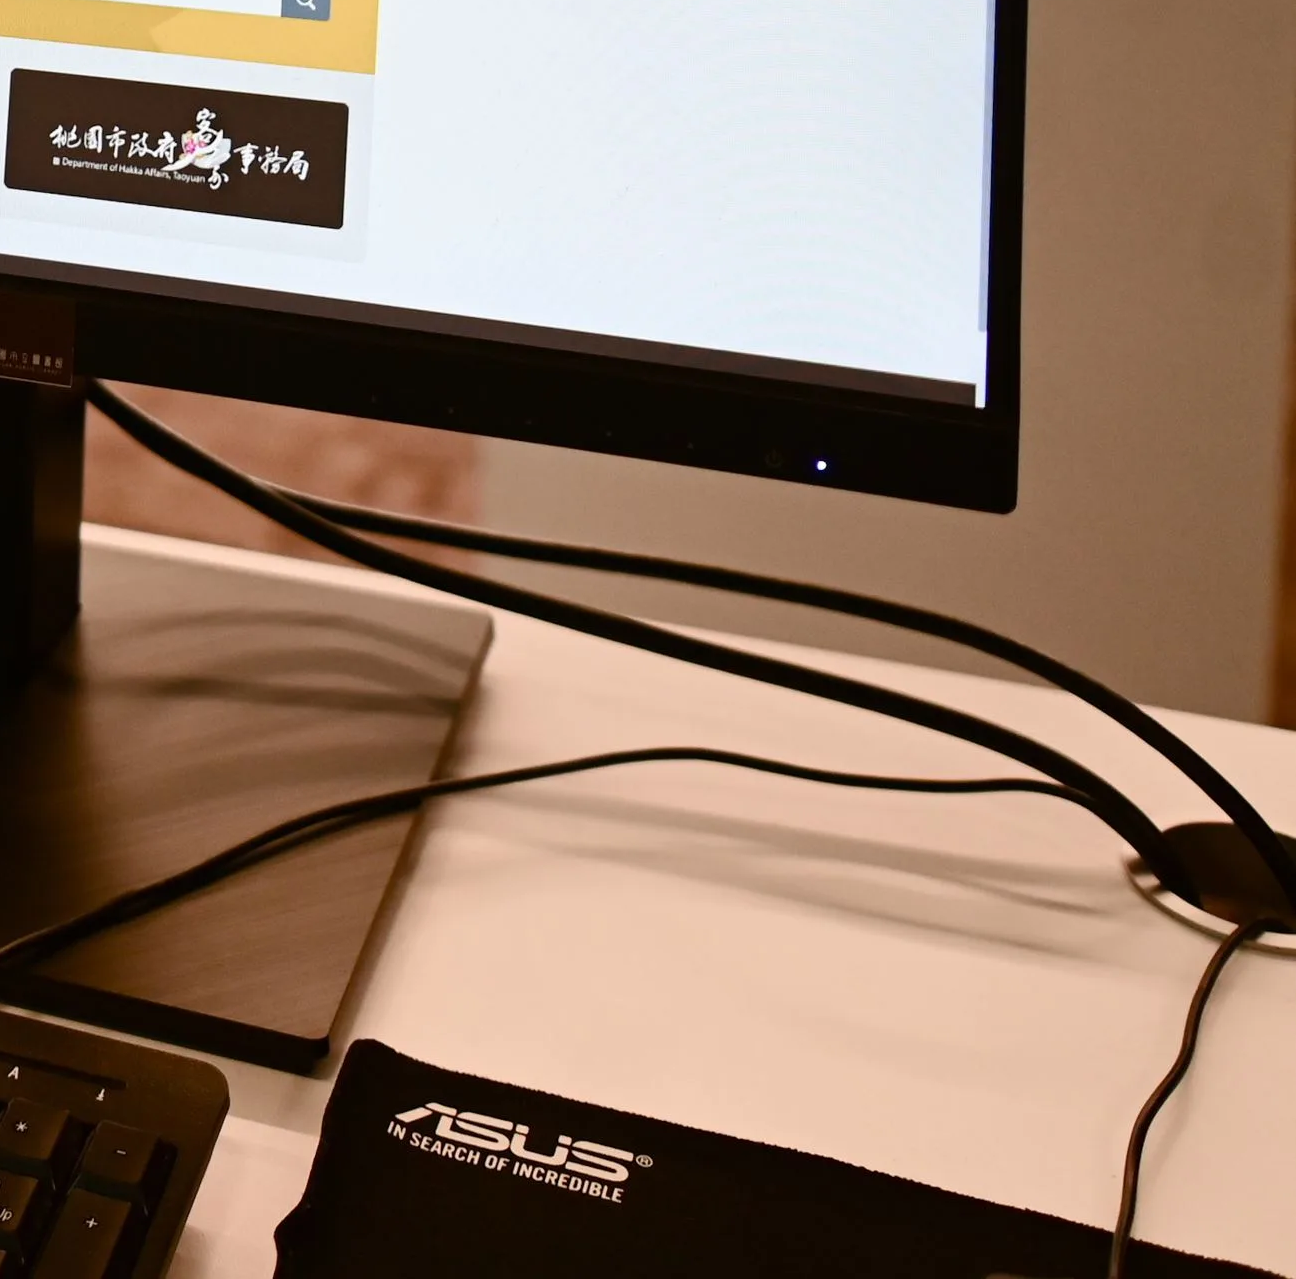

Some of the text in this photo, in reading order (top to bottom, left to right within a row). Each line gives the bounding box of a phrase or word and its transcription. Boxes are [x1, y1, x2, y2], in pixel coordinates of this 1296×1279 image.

[61, 157, 108, 172] Department
[109, 162, 119, 173] of
[118, 163, 144, 176] Hakka
[173, 170, 206, 185] Taoyuan
[8, 1067, 20, 1081] A
[387, 1120, 625, 1204] IN SEARCH OF INCREDIBLE
[86, 1217, 98, 1230] +
